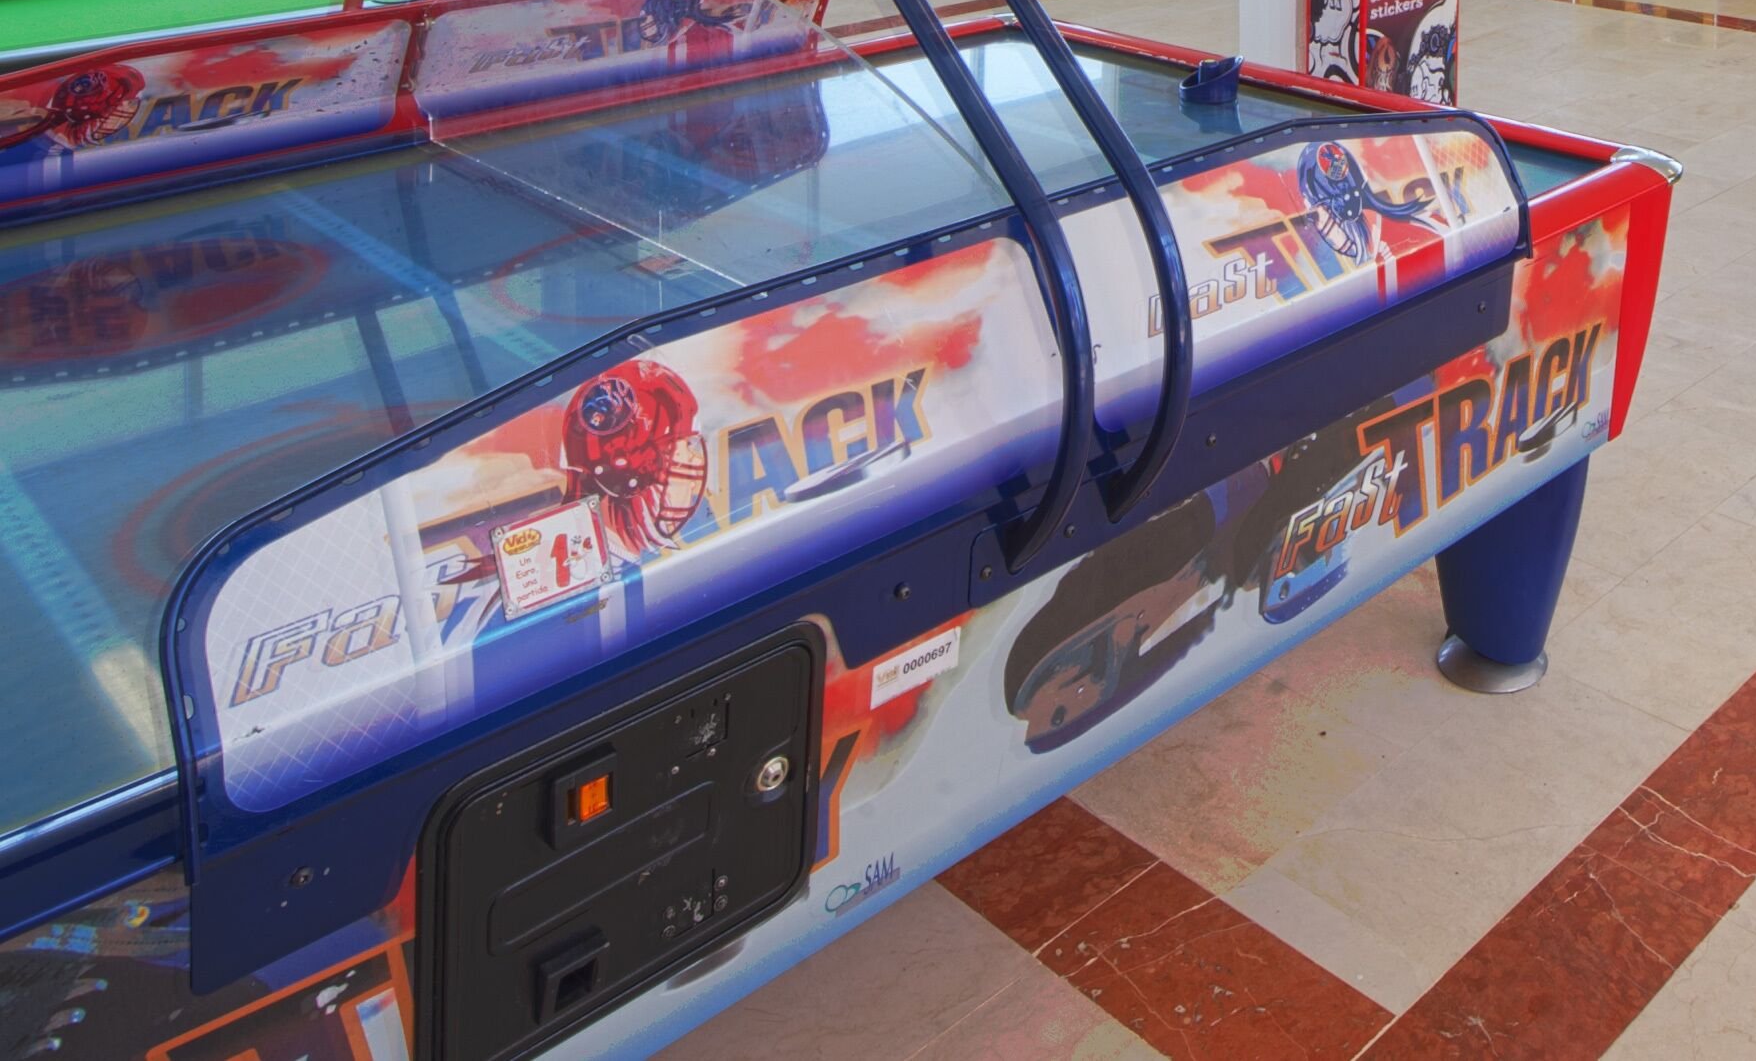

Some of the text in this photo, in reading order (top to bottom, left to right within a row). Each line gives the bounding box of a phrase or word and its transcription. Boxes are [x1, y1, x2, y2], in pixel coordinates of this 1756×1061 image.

[1274, 318, 1608, 580] Fast TRACK
[519, 557, 532, 567] Un
[516, 585, 549, 603] partida
[522, 578, 538, 589] una
[903, 641, 952, 674] 0000697
[864, 852, 895, 888] SAM
